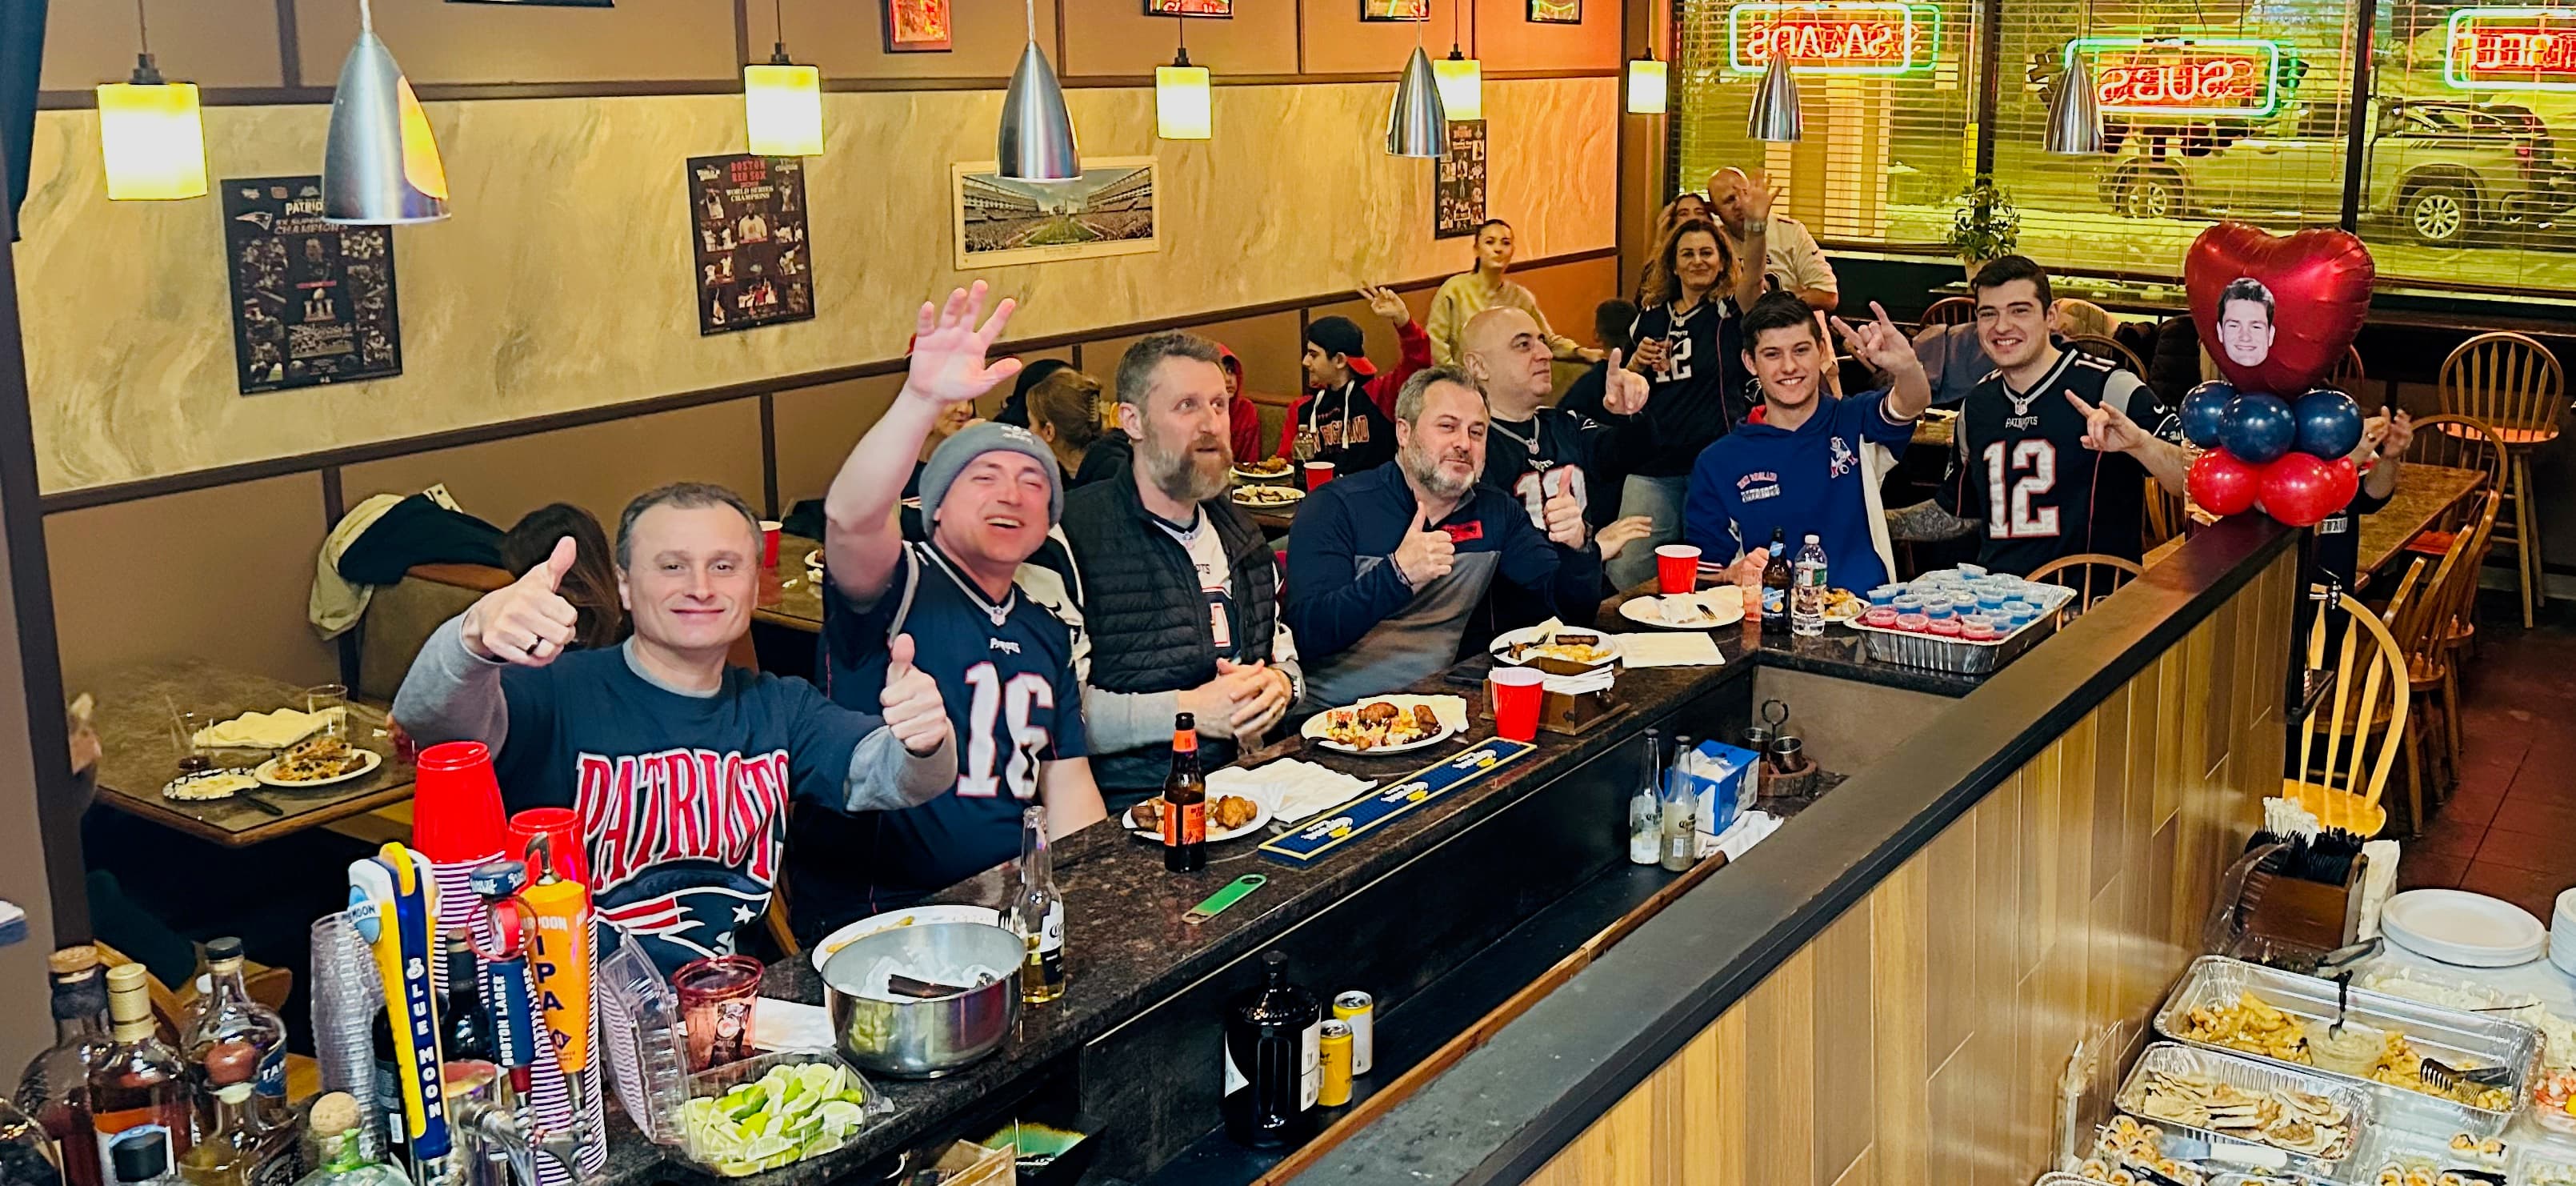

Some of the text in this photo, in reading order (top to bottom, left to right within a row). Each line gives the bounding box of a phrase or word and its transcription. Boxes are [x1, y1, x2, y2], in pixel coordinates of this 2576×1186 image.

[730, 159, 766, 172] BOSTON
[731, 171, 749, 182] RED
[750, 170, 766, 181] SOX
[285, 201, 324, 216] PATRIO
[726, 187, 750, 196] WORLD
[2005, 415, 2038, 431] PATRIOTS
[1982, 439, 2061, 539] 12
[955, 660, 1054, 799] 16
[535, 935, 565, 1011] IPA
[406, 956, 442, 1120] BLUE MOON
[492, 974, 515, 1066] BOSTON LAGER
